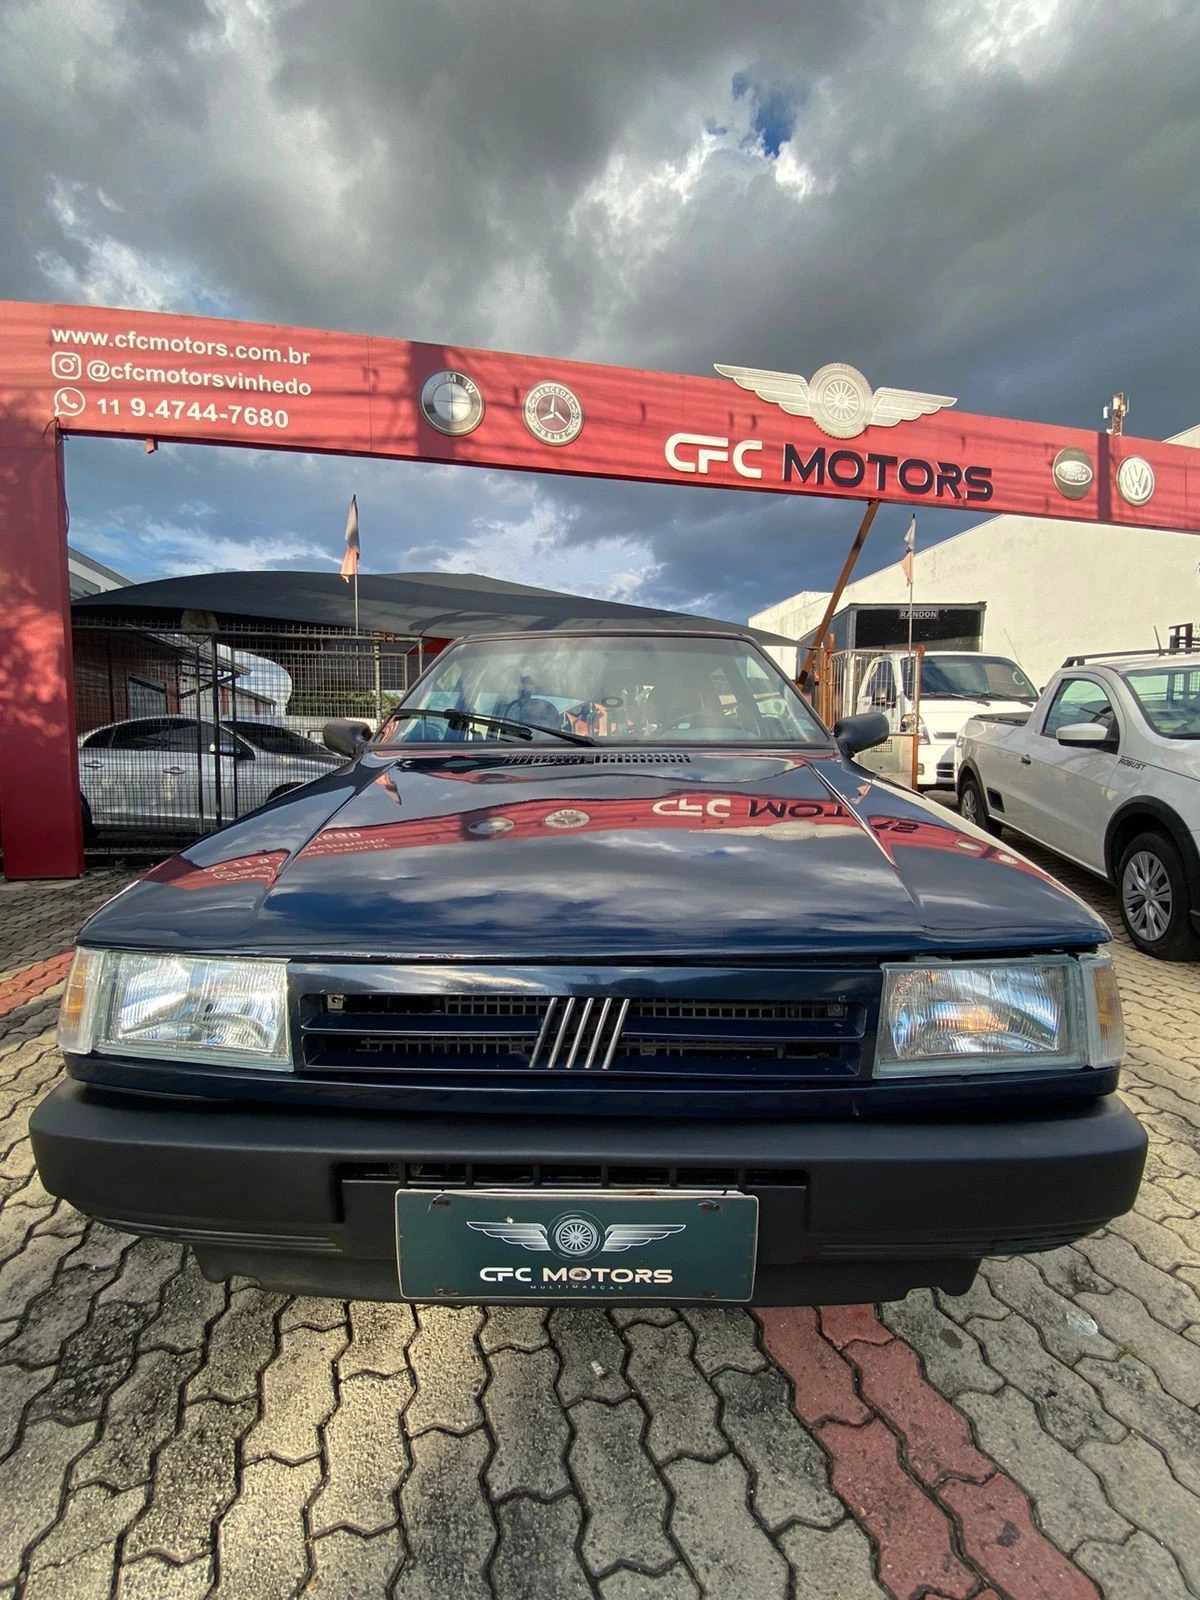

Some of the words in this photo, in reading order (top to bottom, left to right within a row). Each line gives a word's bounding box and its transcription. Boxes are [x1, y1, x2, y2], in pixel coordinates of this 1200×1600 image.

[51, 328, 311, 366] www.cfcmotors.com.br
[87, 360, 312, 397] @cfcmotorsvinhedo
[97, 398, 120, 416] 11
[130, 398, 289, 429] 9.4744-7680
[665, 432, 763, 479] CFC
[782, 443, 993, 501] MOTORS
[900, 610, 937, 618] RANDON
[479, 1267, 532, 1282] CFC
[542, 1267, 674, 1284] MOTORS
